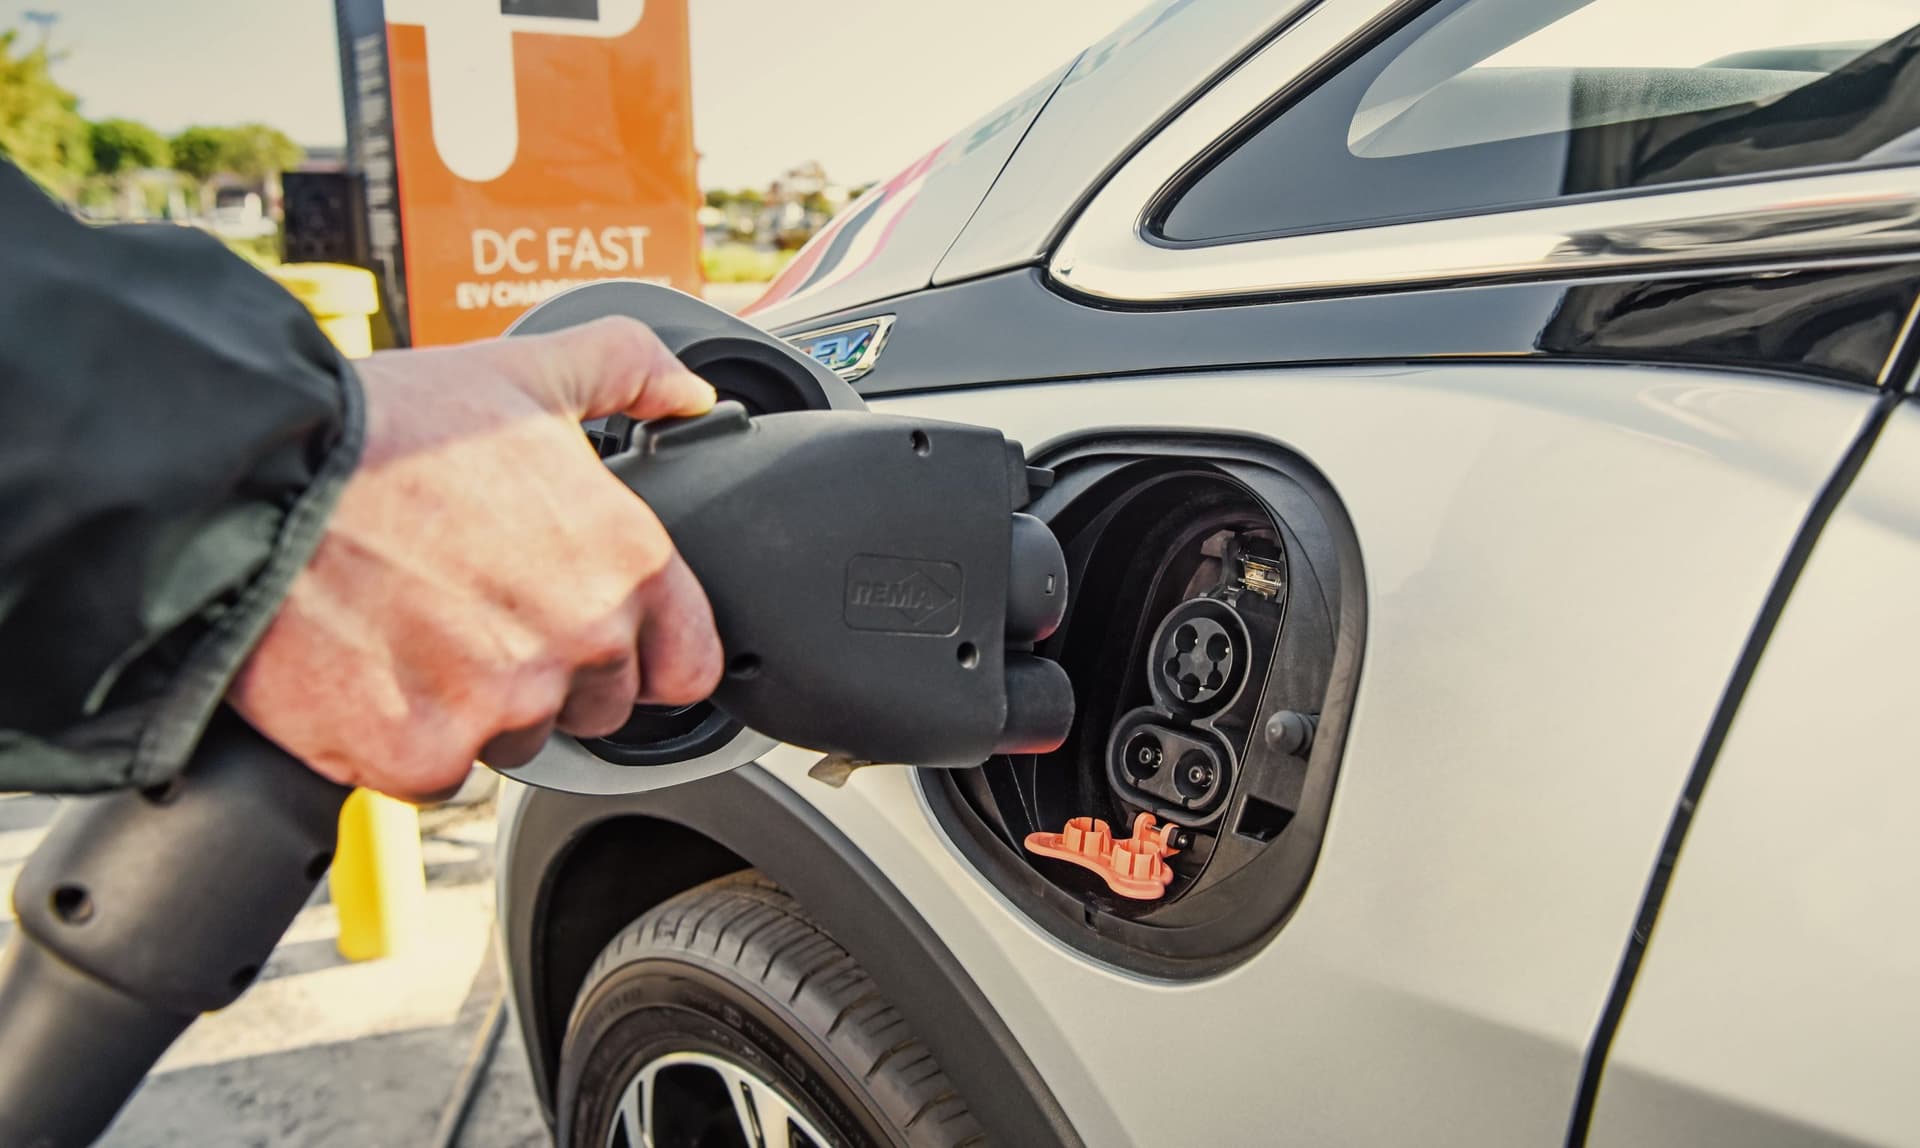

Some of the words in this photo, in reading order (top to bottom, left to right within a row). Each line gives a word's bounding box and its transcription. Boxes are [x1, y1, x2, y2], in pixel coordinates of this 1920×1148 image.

[471, 227, 538, 275] DC
[546, 226, 650, 272] FAST
[456, 281, 490, 309] EV
